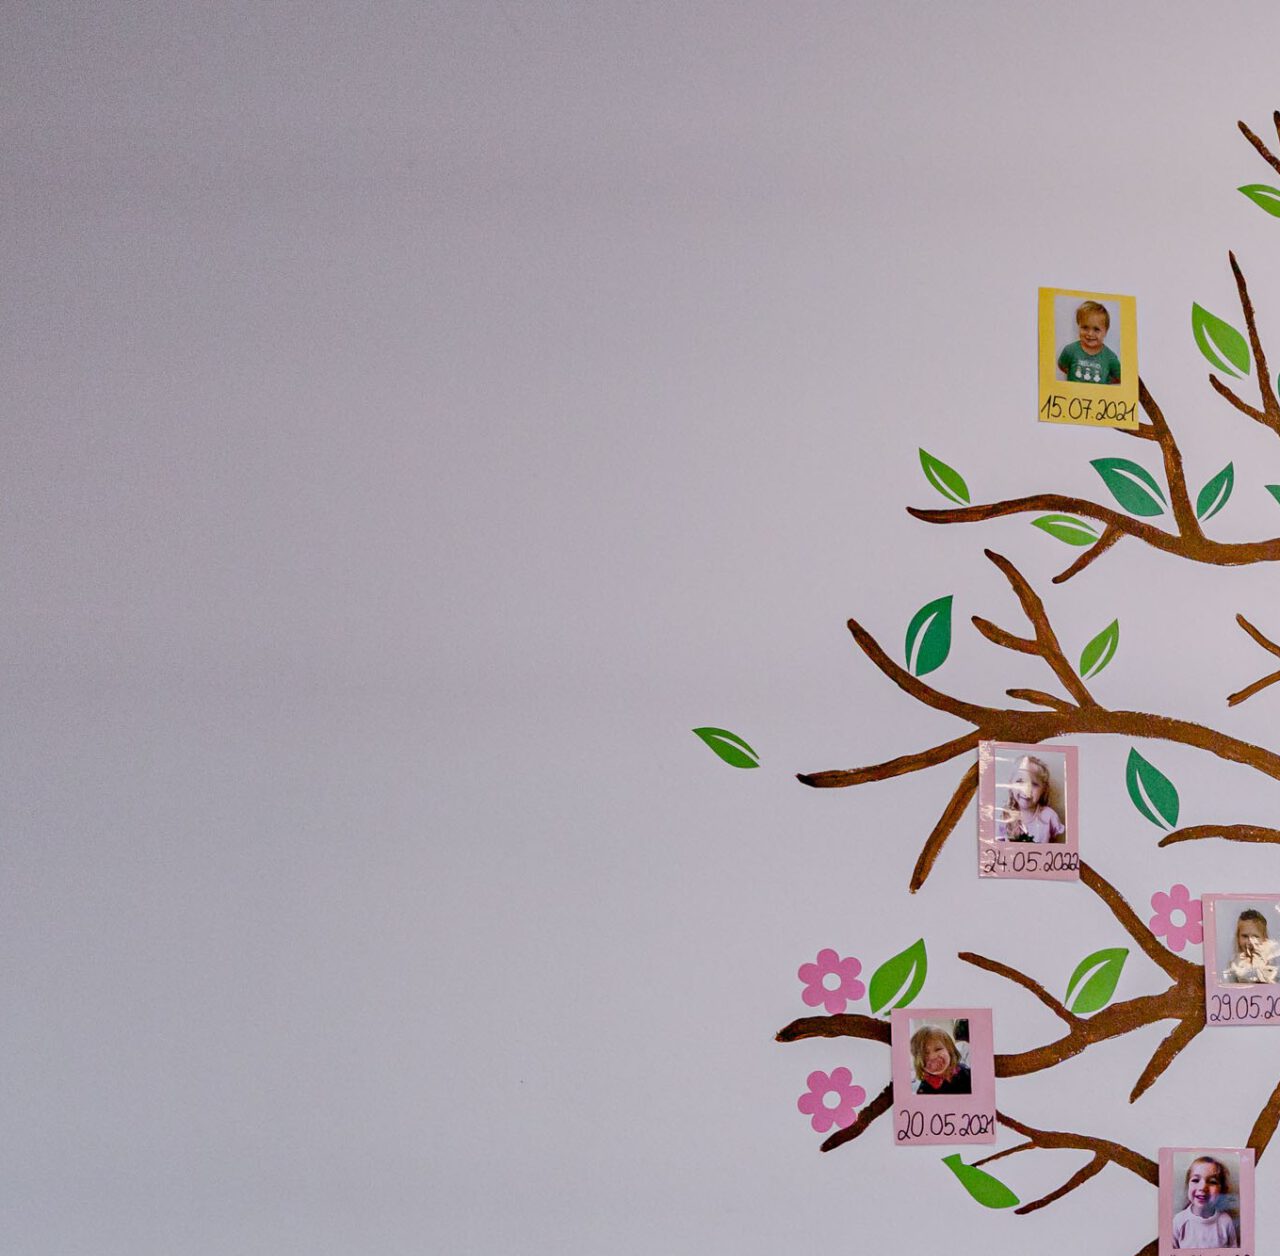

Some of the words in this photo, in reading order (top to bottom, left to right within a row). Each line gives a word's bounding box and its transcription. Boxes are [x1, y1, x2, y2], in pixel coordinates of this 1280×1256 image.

[1040, 394, 1136, 421] 15.07.2021
[984, 849, 1079, 873] 24.05.2022
[897, 1109, 994, 1141] 20.05.2021
